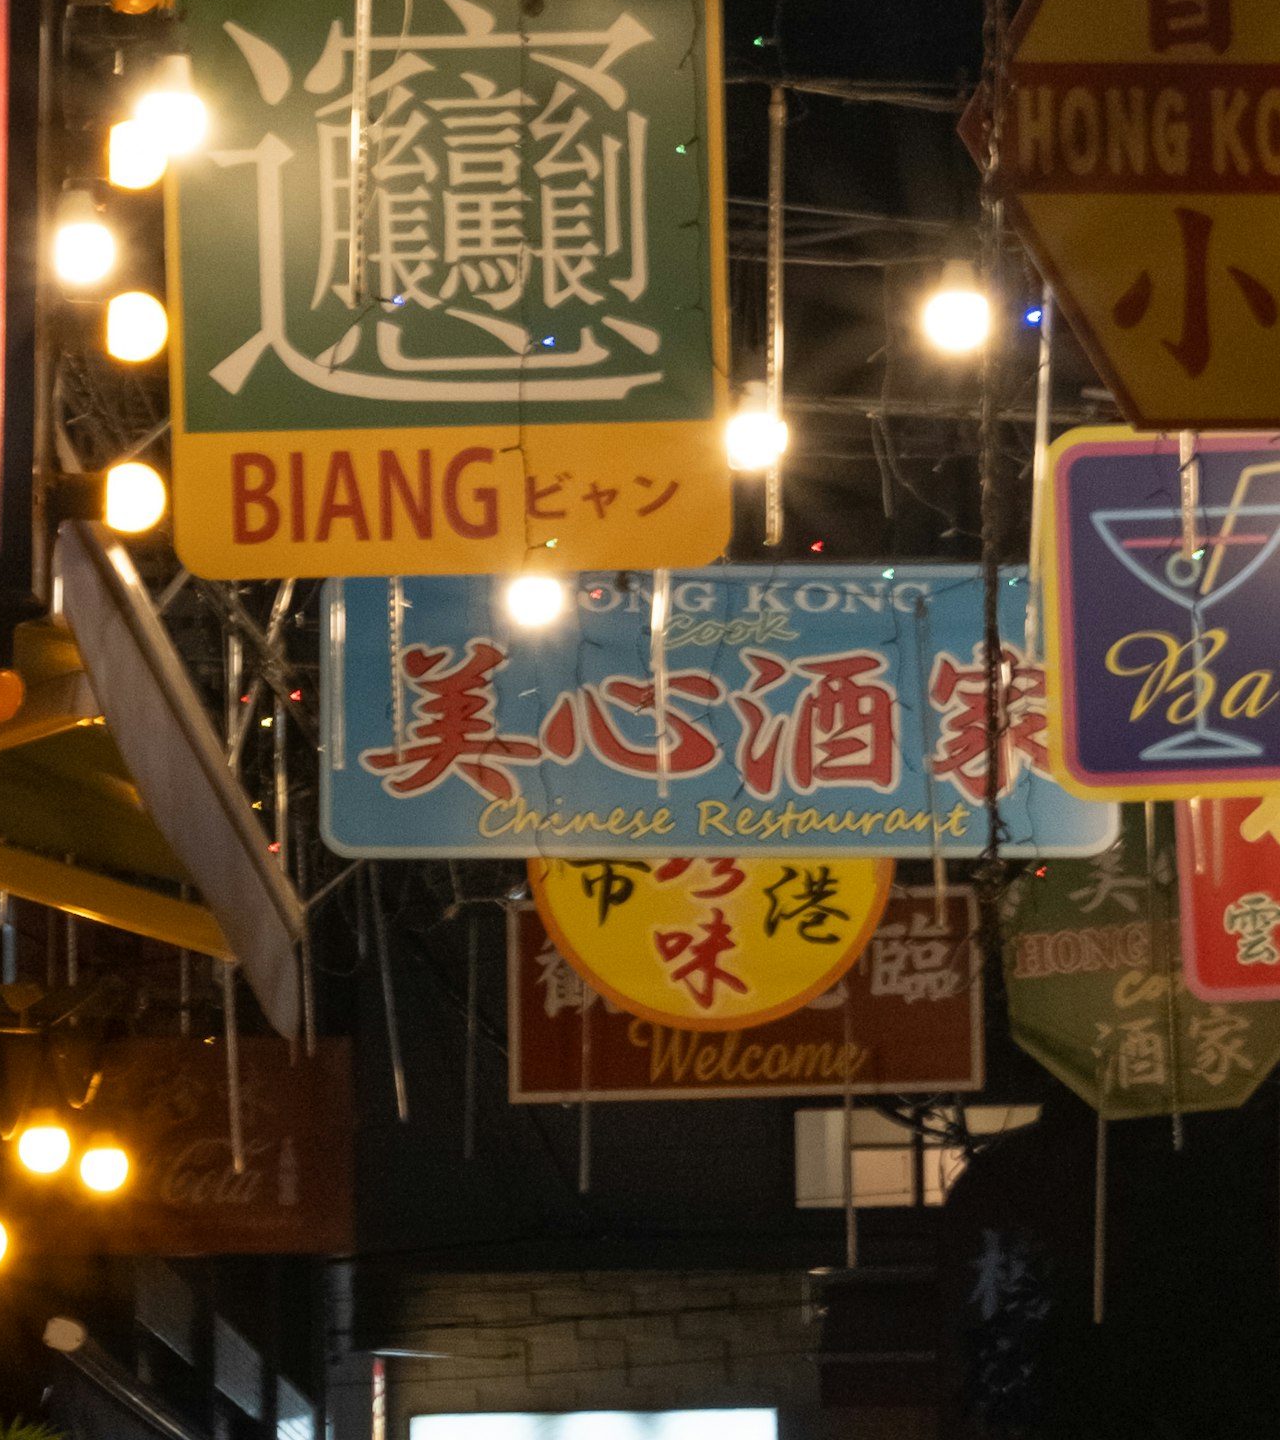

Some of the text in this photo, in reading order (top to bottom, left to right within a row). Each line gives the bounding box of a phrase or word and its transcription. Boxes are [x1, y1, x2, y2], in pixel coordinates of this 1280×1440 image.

[1021, 86, 1193, 177] HONG
[231, 447, 499, 545] BIANG
[525, 472, 680, 520] ビャン
[577, 581, 931, 614] ONG KONG
[360, 640, 1052, 804] 美心酒家
[478, 796, 971, 840] Chinese Restaurant
[628, 1018, 870, 1083] Welcome
